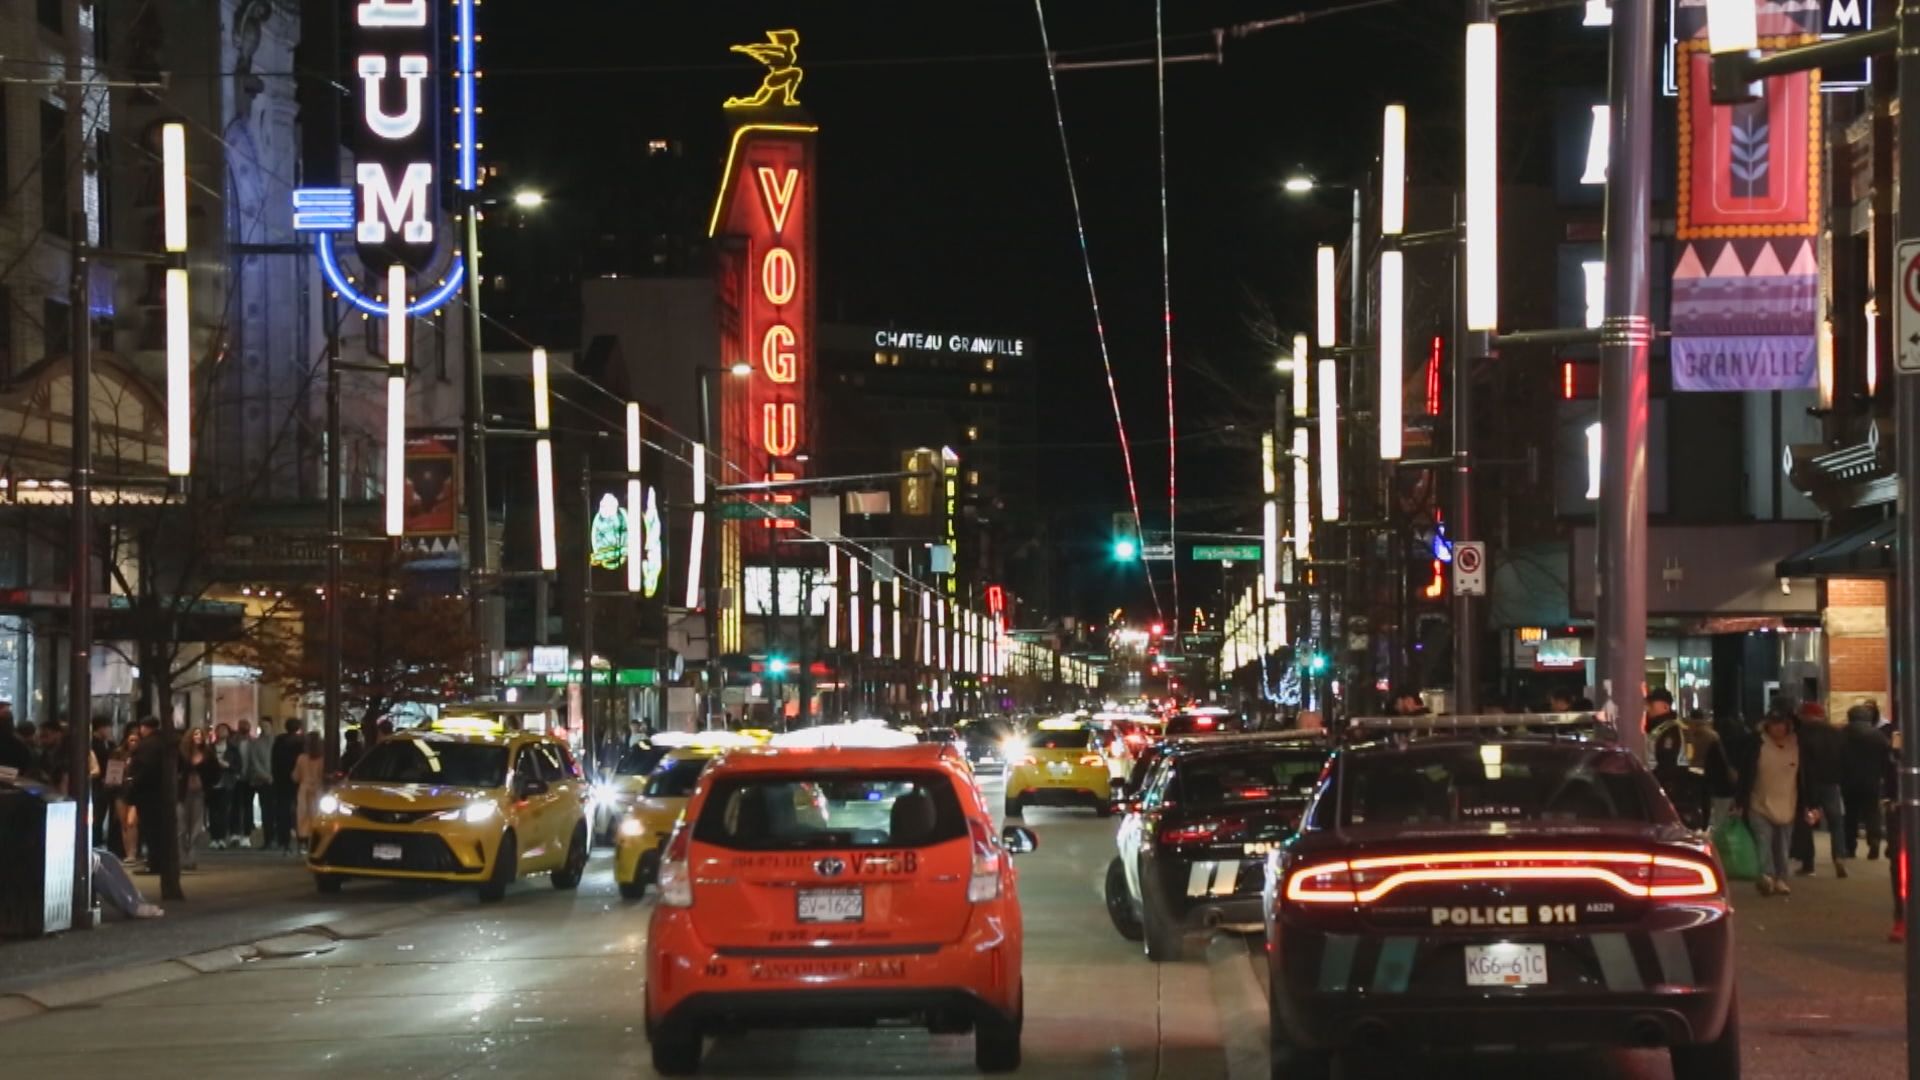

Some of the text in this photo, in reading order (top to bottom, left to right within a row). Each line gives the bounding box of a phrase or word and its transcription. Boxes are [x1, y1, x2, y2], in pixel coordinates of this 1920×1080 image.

[758, 167, 799, 528] VOGUE
[875, 331, 1023, 356] CHATEAU GRANVILLE
[1685, 351, 1805, 377] GRANVILLE
[1463, 806, 1521, 815] vpd.ca
[850, 851, 917, 874] V315B
[1431, 904, 1576, 924] POLICE 911
